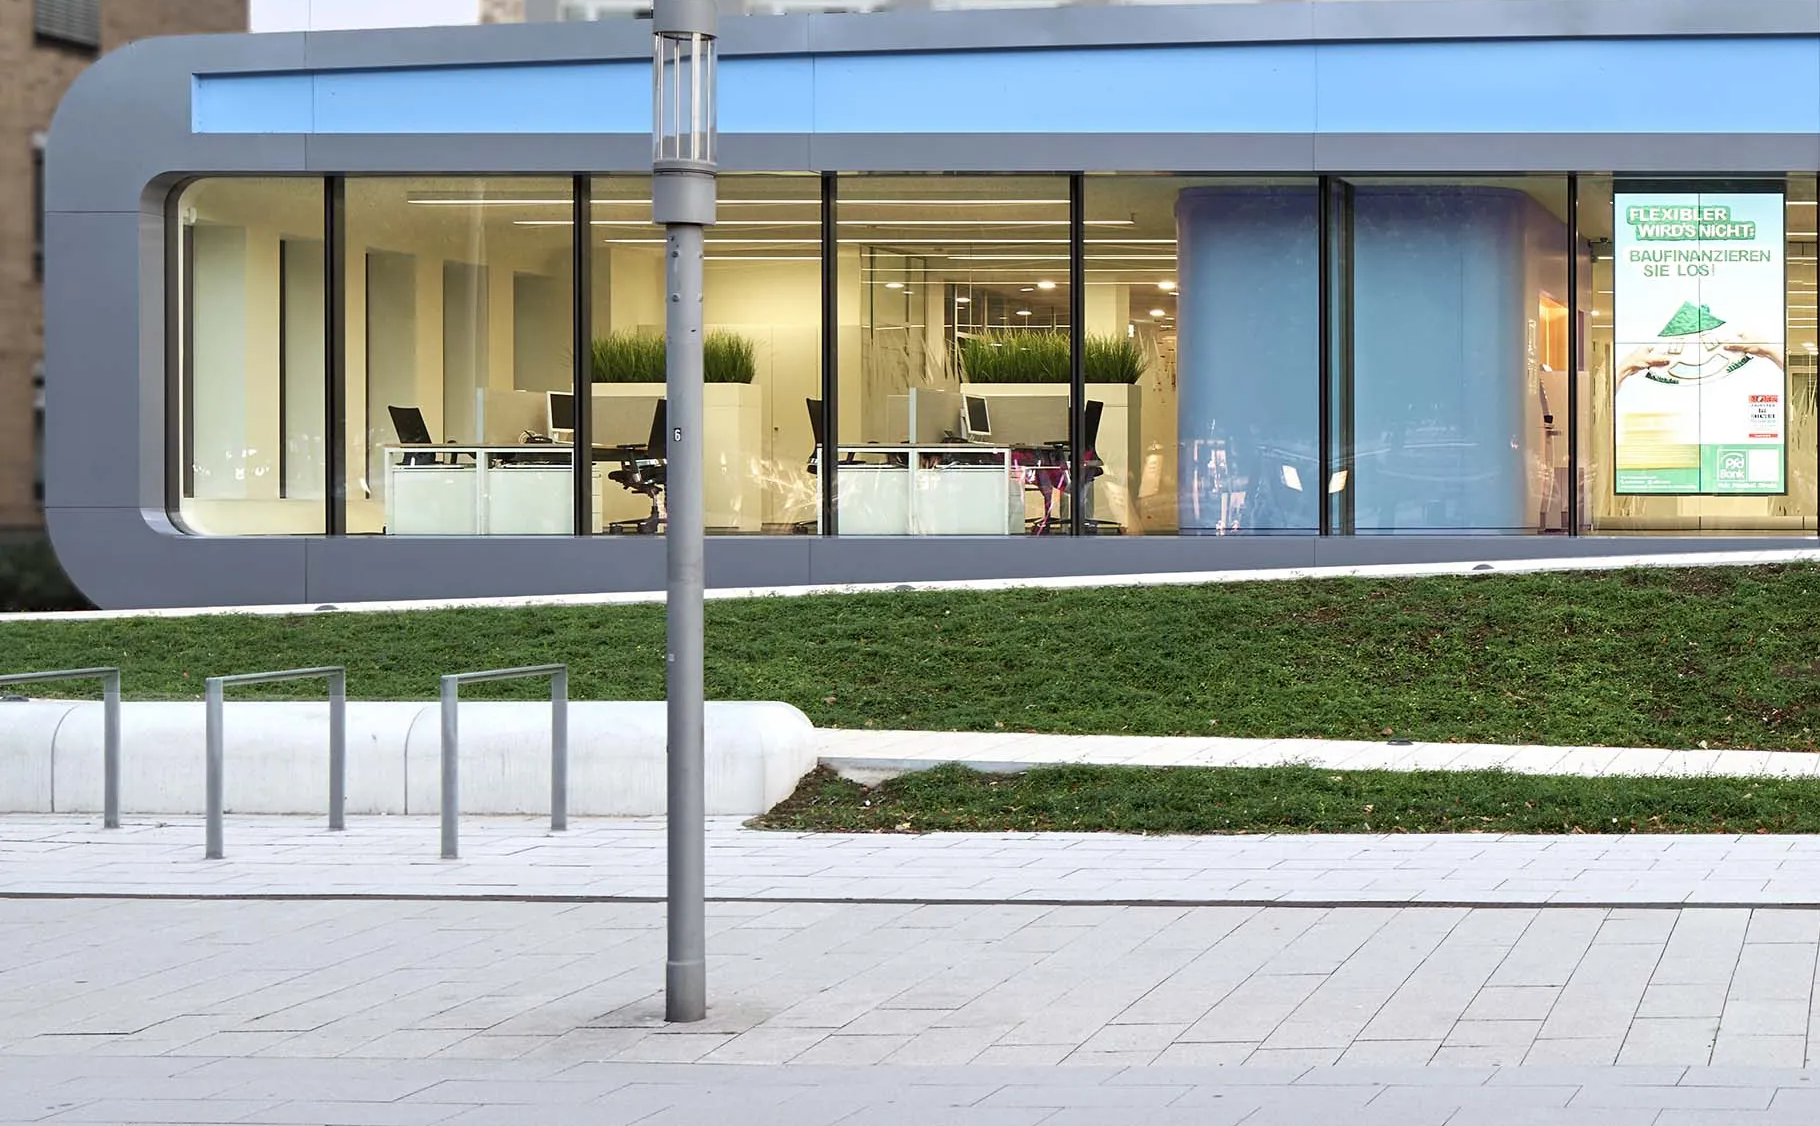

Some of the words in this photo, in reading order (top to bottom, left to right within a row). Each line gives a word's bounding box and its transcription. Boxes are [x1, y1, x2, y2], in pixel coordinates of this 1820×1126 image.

[1629, 207, 1728, 222] FLEXIBLER
[1630, 249, 1771, 262] BAUFINANZIEREN
[1643, 264, 1670, 277] SIE
[1677, 264, 1715, 277] LOS!
[674, 429, 681, 442] 6
